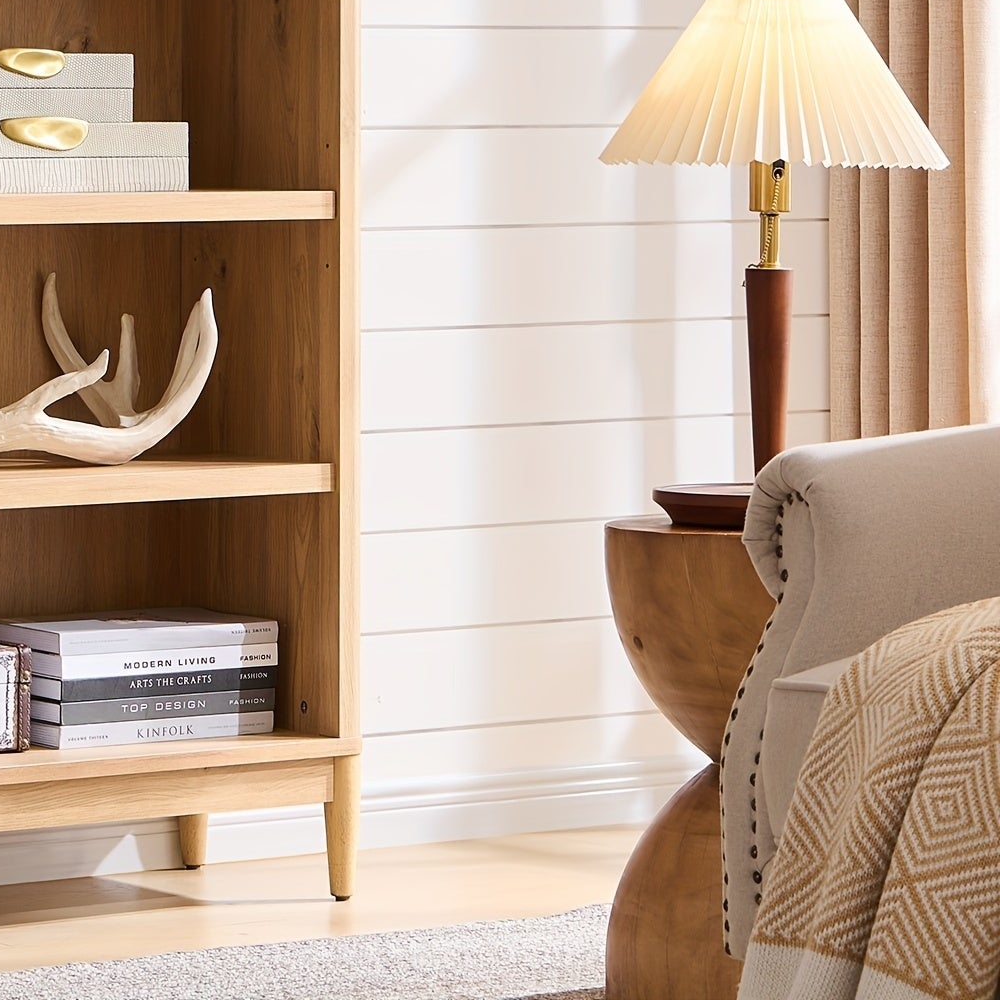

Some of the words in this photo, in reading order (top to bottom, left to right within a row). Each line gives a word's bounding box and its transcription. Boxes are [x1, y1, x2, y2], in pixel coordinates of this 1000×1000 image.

[124, 658, 172, 670] MODERN
[178, 656, 216, 666] LIVING
[240, 653, 272, 662] FASHION
[130, 678, 153, 689] ARTS
[156, 676, 174, 687] THE
[177, 674, 212, 686] CRAFTS
[239, 672, 268, 680] FASHION
[122, 702, 148, 713] TOP
[156, 700, 206, 710] DESIGN
[229, 697, 265, 705] FASHION
[136, 725, 194, 739] KINFOLK
